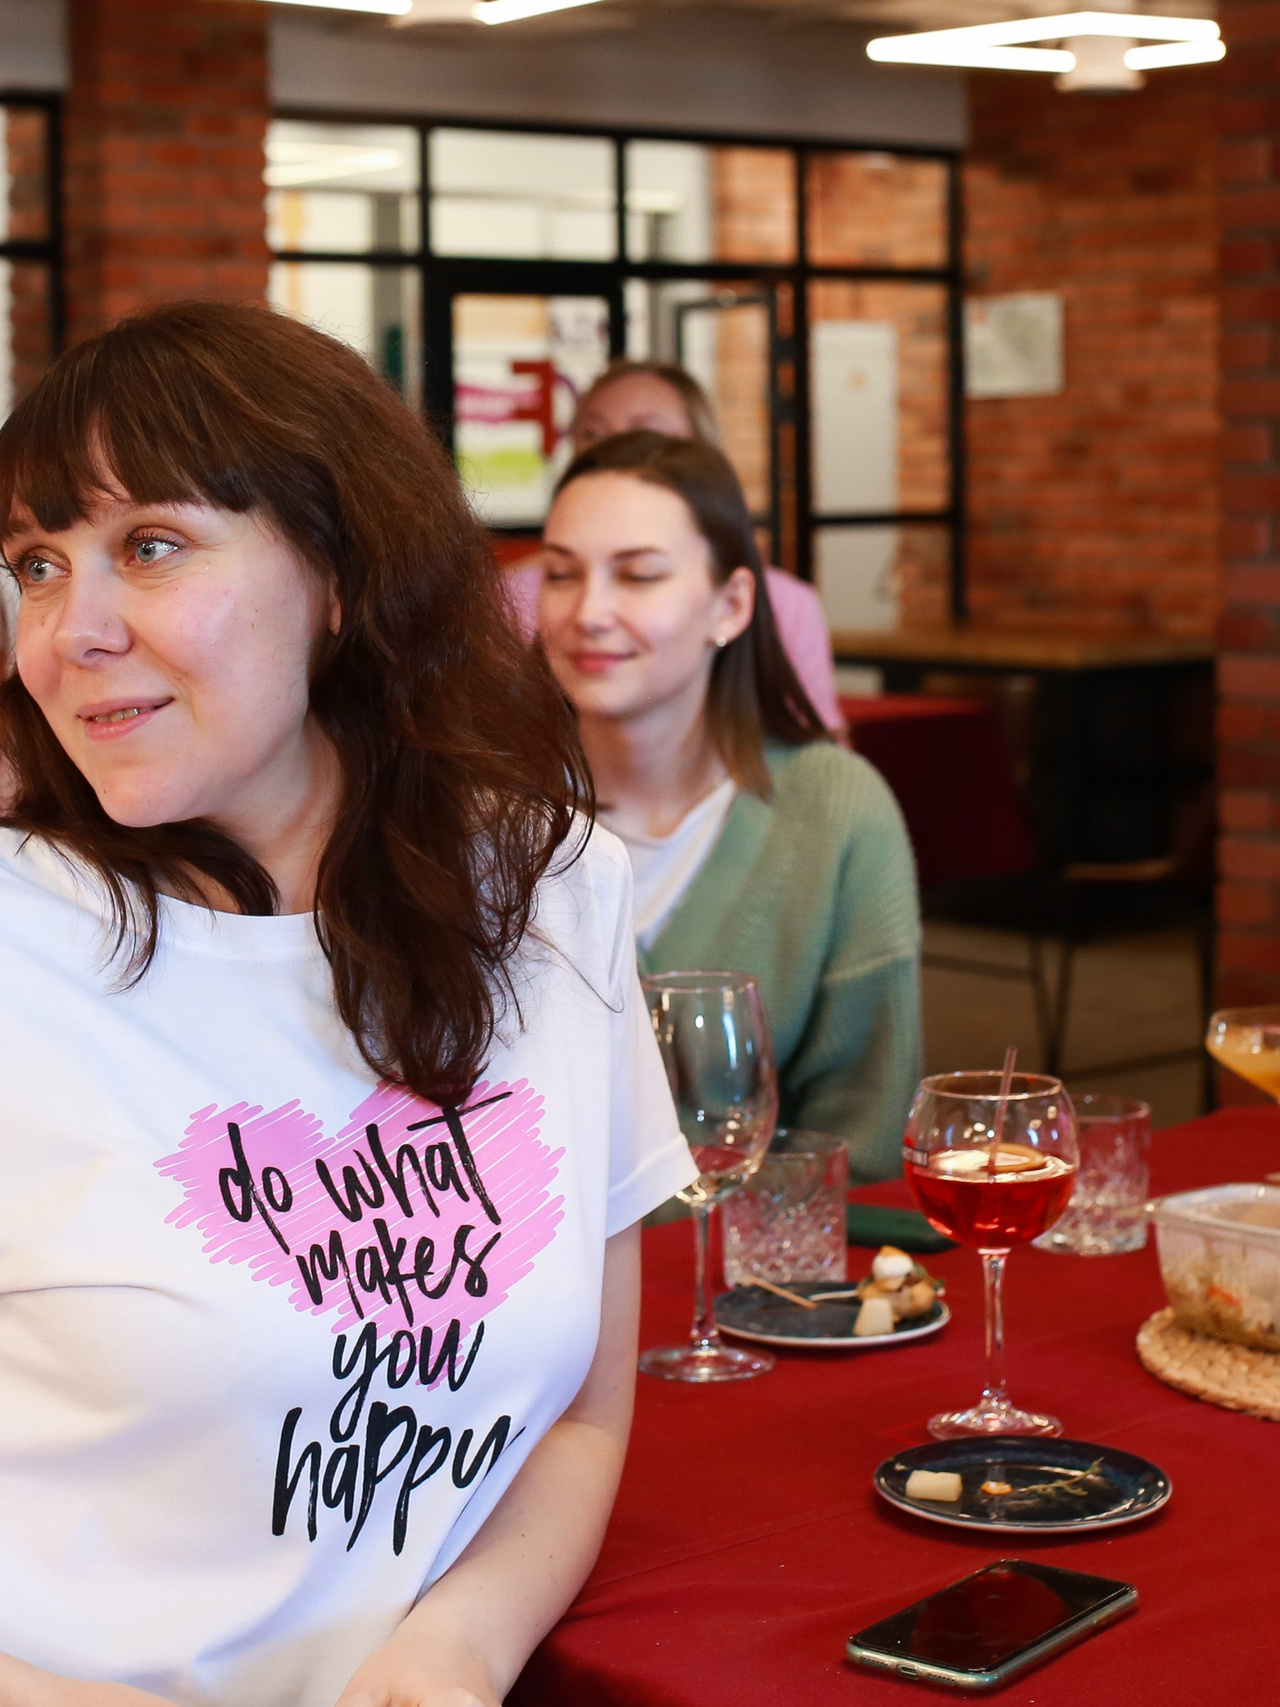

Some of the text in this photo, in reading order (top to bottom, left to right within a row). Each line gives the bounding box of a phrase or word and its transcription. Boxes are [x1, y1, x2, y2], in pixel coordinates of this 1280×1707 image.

[219, 1091, 513, 1256] do what
[295, 1218, 502, 1328] makes
[329, 1318, 485, 1443] you
[271, 1401, 526, 1557] happy
